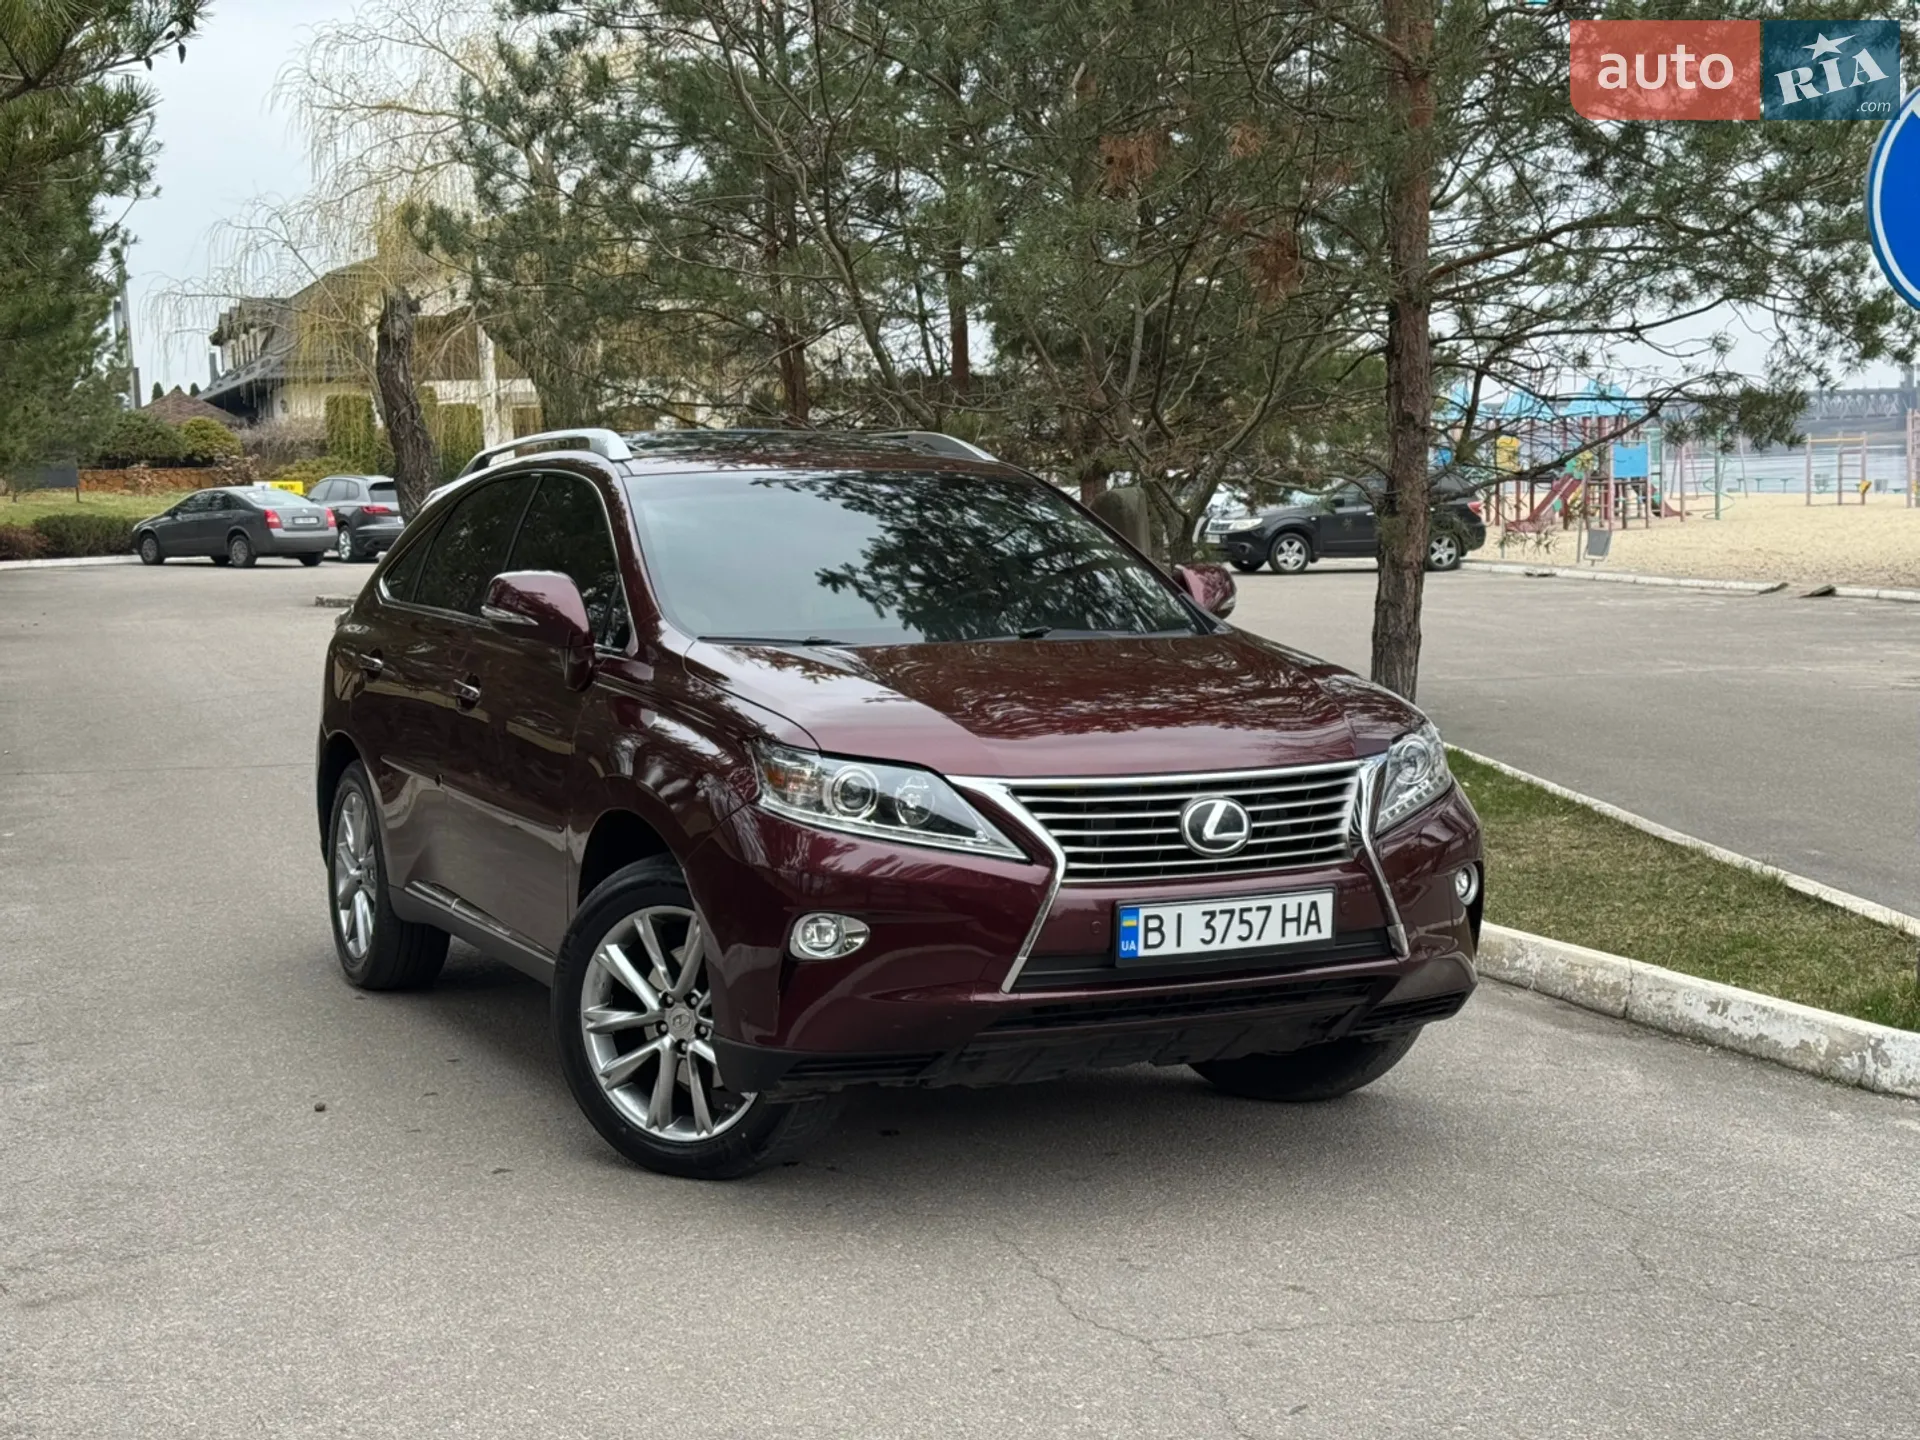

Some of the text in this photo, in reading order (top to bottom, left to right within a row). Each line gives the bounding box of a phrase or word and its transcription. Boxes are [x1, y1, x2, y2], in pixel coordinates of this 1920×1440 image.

[1143, 900, 1322, 950] BI 3757 HA
[1121, 940, 1137, 951] UA
